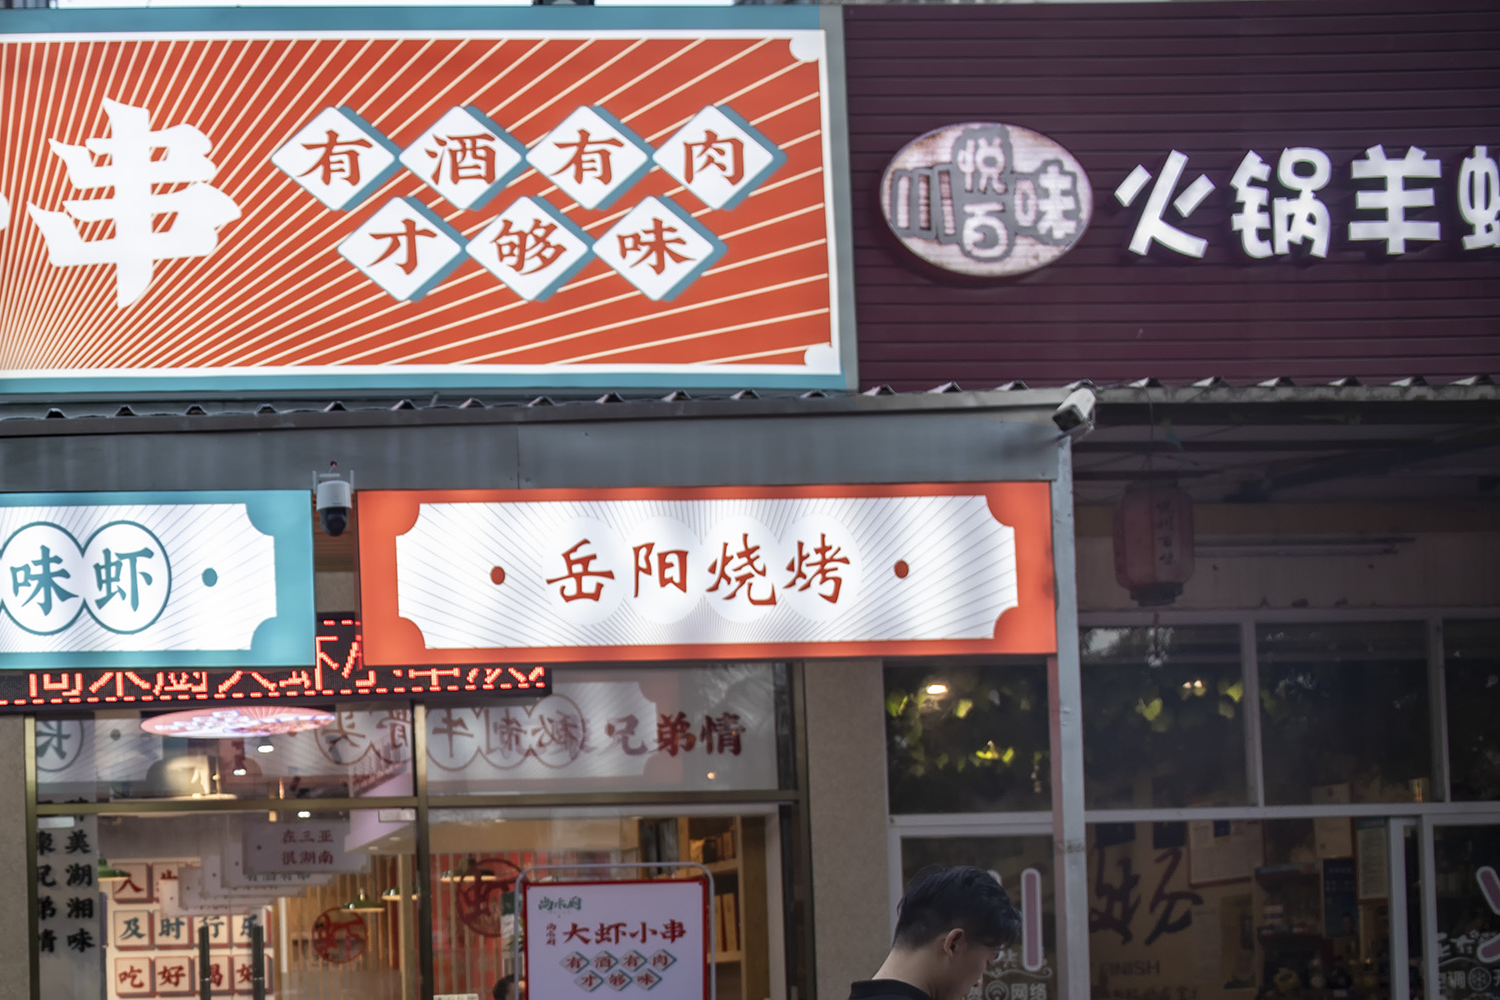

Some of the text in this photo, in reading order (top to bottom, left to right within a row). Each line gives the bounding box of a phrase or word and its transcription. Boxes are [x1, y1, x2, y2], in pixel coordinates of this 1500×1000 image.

[298, 128, 746, 188] 有酒有肉
[365, 216, 696, 277] 才够味
[545, 531, 851, 606] 岳阳烧烤
[282, 829, 334, 845] 在三亚
[562, 919, 687, 945] 大虾小串
[565, 953, 669, 970] 有酒有肉
[580, 972, 655, 987] 才够味
